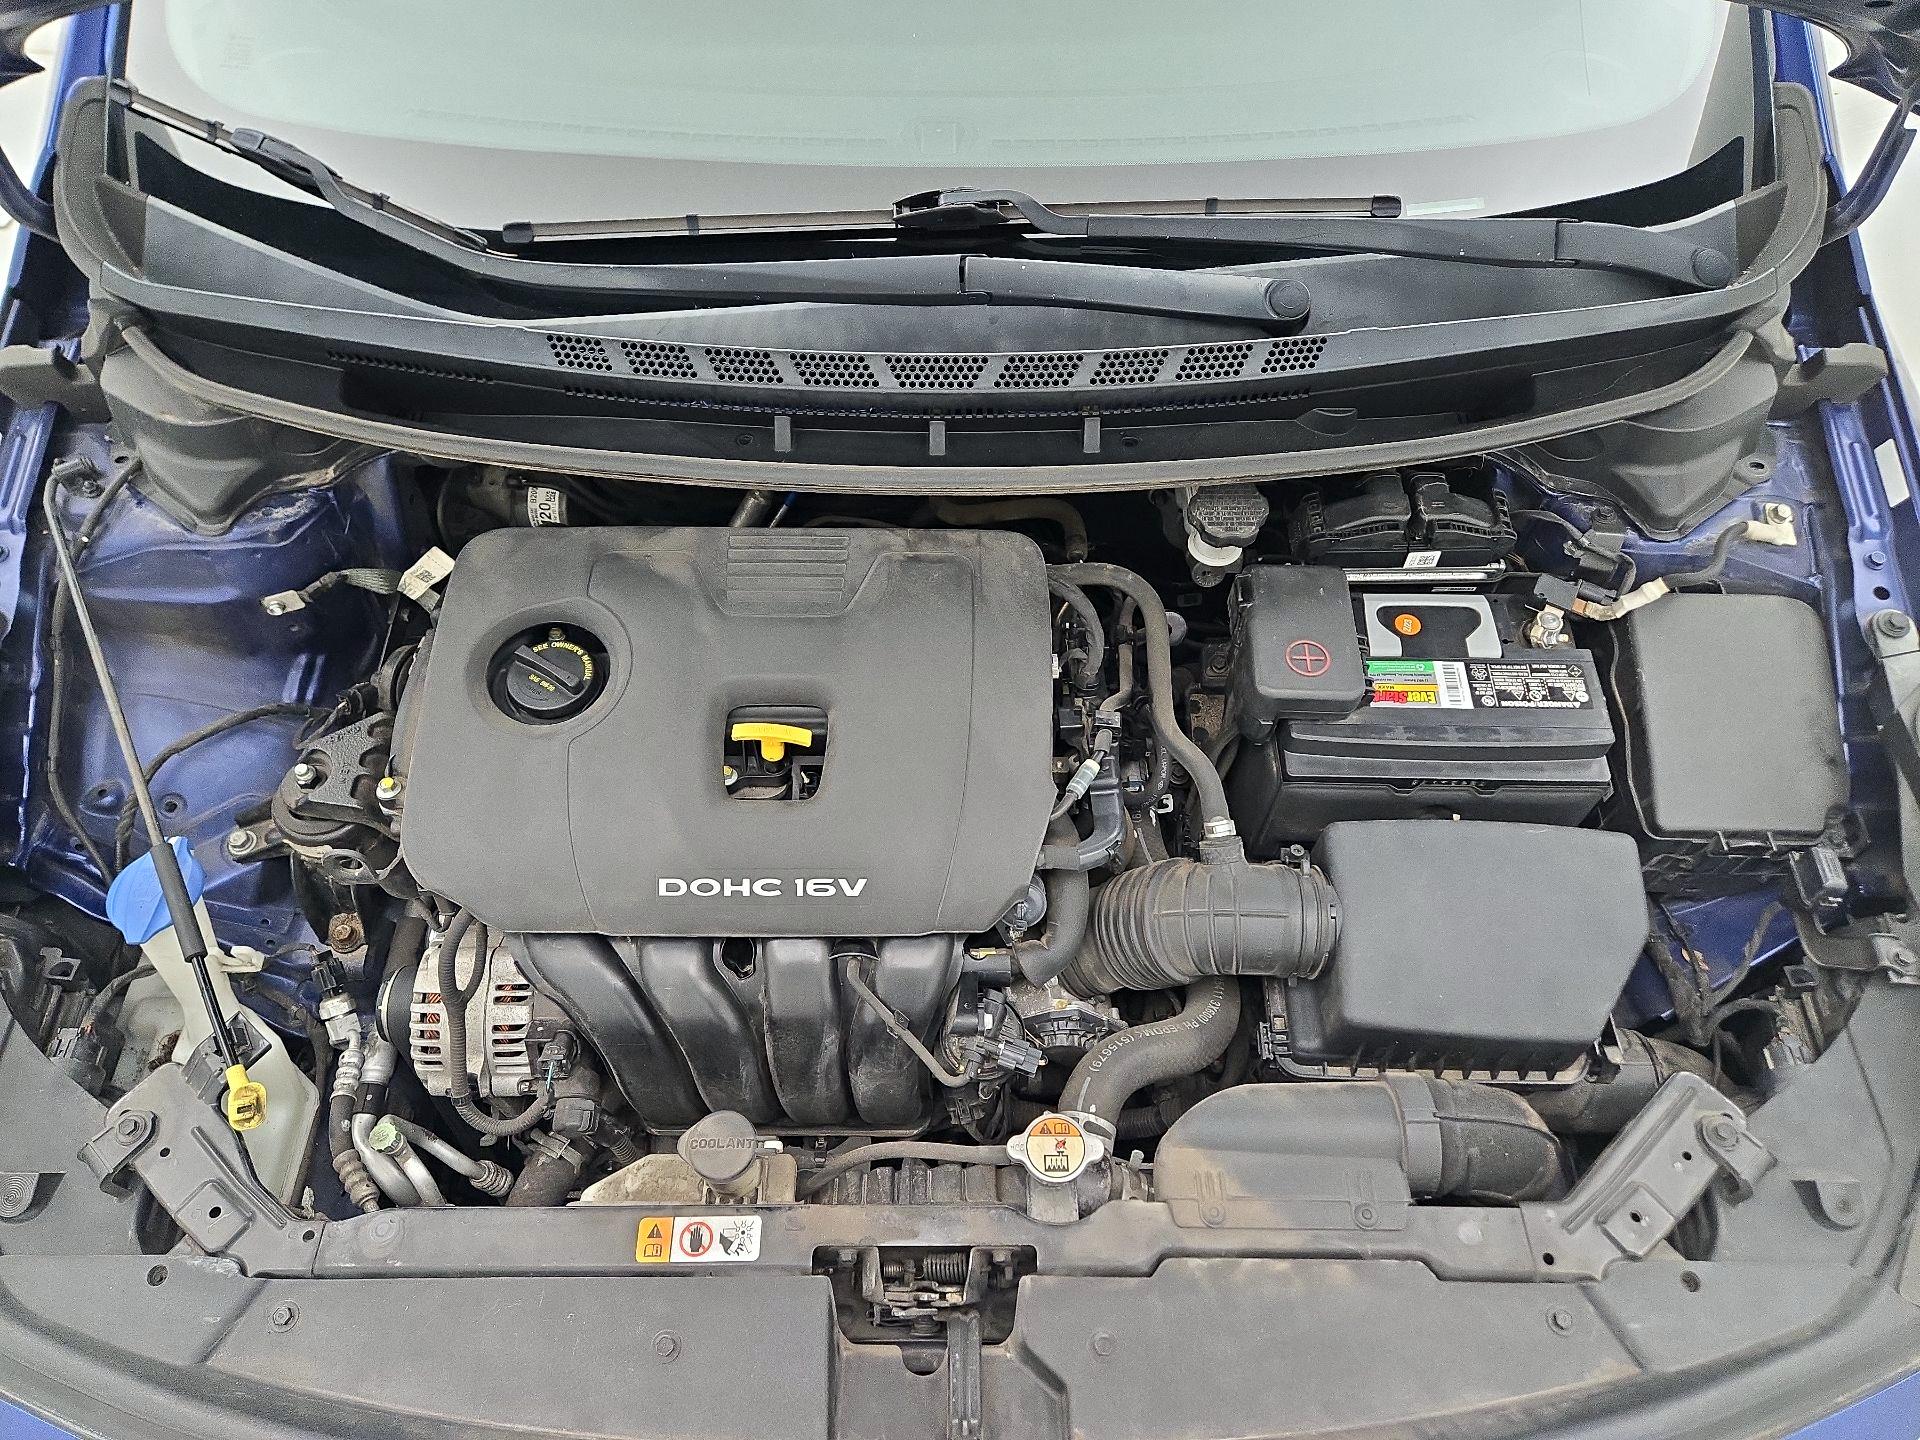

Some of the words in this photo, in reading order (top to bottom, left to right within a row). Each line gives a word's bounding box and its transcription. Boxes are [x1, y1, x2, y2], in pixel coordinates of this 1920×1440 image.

[532, 643, 548, 653] SEE
[581, 655, 593, 680] MANUAL
[658, 878, 783, 897] DOHC
[794, 878, 868, 897] 16V
[690, 1137, 758, 1150] COOLANT
